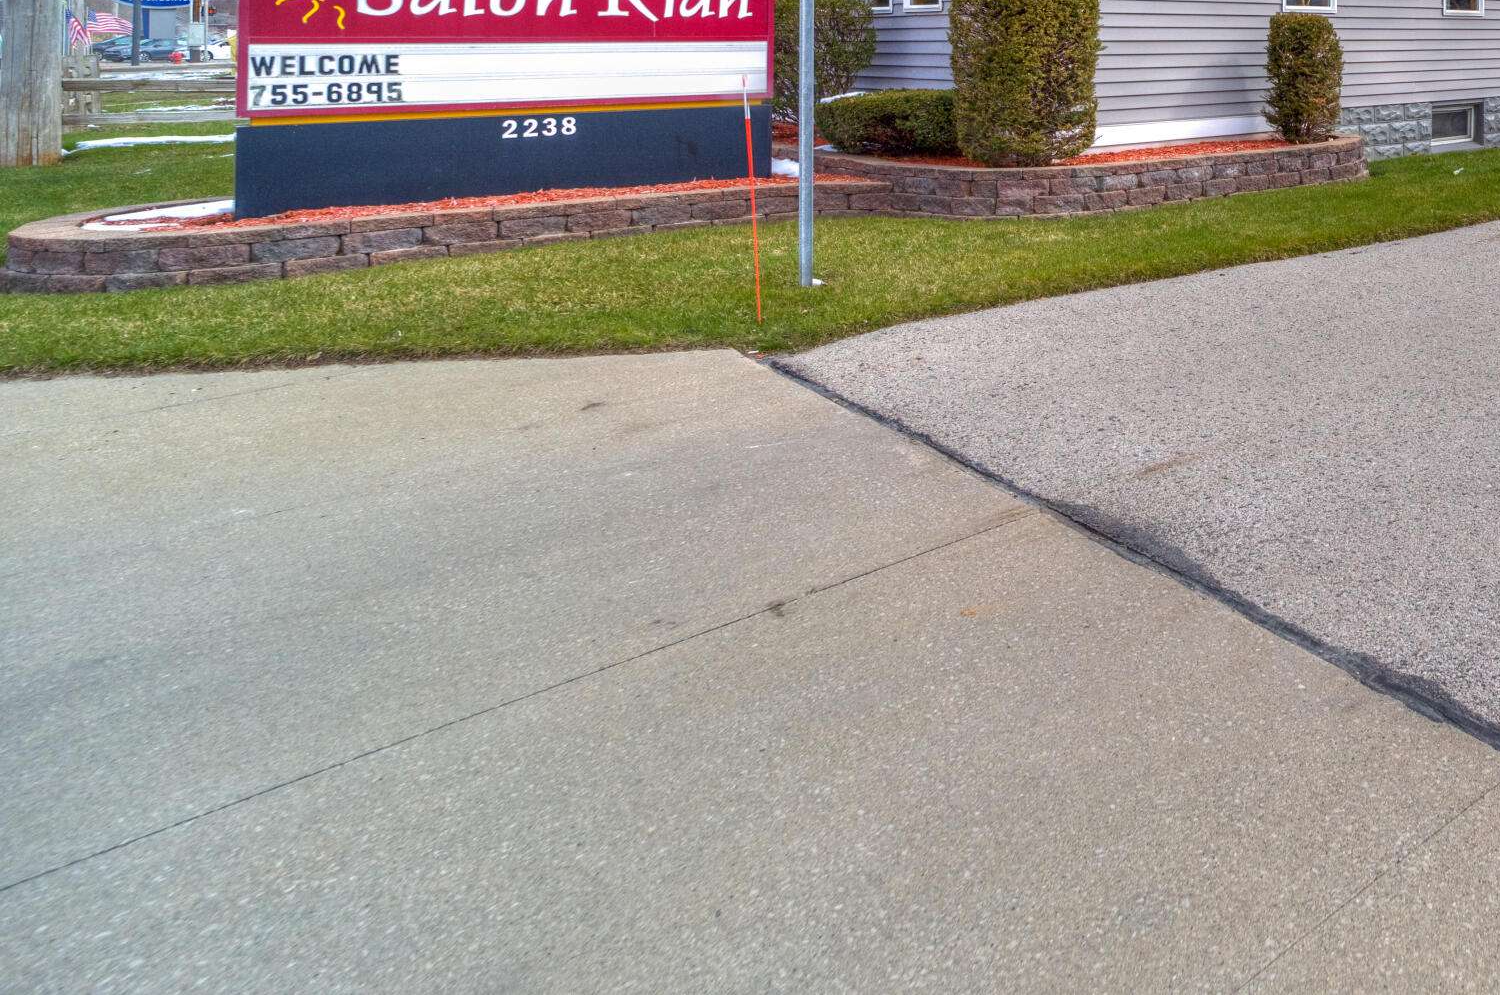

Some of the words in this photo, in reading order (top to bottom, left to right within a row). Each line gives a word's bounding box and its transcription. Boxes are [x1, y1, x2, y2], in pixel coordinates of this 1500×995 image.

[251, 55, 400, 76] WELCOME
[249, 82, 403, 106] 755-6895
[501, 116, 577, 139] 2238
